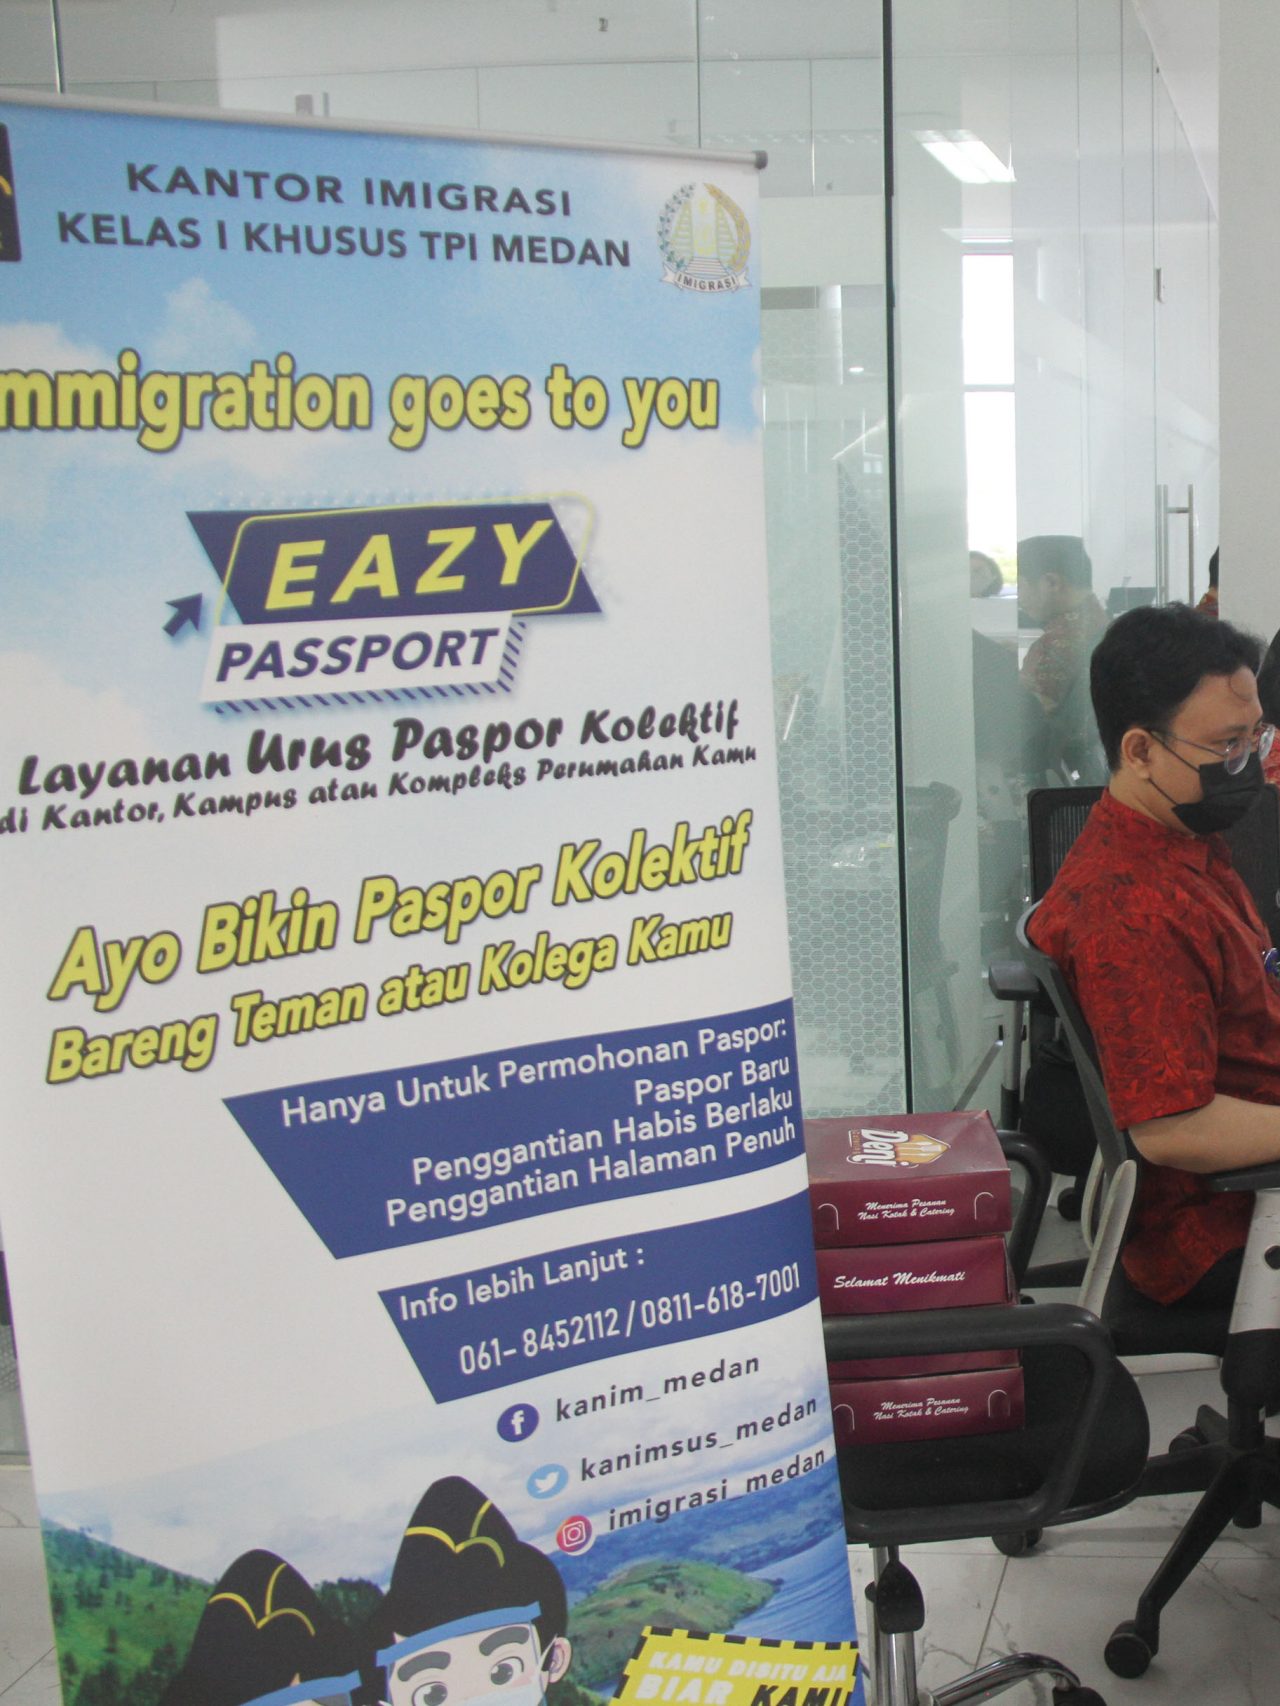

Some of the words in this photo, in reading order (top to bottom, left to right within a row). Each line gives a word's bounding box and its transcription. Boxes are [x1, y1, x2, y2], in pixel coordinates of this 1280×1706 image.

[127, 163, 343, 204] KANTOR
[364, 177, 571, 217] IMIGRASI
[57, 211, 201, 249] KELAS
[217, 219, 227, 250] I
[244, 222, 407, 259] KHUSUS
[420, 231, 477, 261] TPI
[492, 235, 630, 267] MEDAN
[676, 273, 736, 291] IMIGRASI
[389, 373, 532, 450] goes
[547, 364, 608, 430] to
[622, 377, 720, 448] you
[264, 519, 553, 610] EAZY
[215, 628, 499, 682] PASSPORT
[18, 753, 231, 797] Layanan
[247, 729, 371, 773] Urus
[392, 717, 564, 764] Paspor
[579, 699, 740, 744] Kolektif
[0, 806, 28, 834] di
[41, 799, 165, 832] Kantor,
[172, 787, 297, 819] Kampus
[308, 779, 378, 806] atau
[389, 764, 527, 798] Kompleks
[536, 753, 683, 780] Perumahan
[691, 744, 757, 767] Kamu
[46, 925, 182, 1012] Ayo
[198, 888, 337, 972] Bikin
[353, 862, 540, 944] Paspor
[552, 809, 754, 907] Kolektif
[45, 1012, 219, 1085] Bareng
[230, 982, 366, 1048] Teman
[377, 960, 469, 1018] atau
[478, 931, 615, 995] Kolega
[626, 908, 734, 968] Kamu
[281, 1091, 388, 1128] Hanya
[396, 1072, 491, 1106] Untuk
[498, 1038, 690, 1090] Permohonan
[697, 1018, 788, 1060] Paspor:
[634, 1071, 732, 1109] Paspor
[741, 1054, 791, 1086] Baru
[412, 1125, 603, 1188] Penggantian
[612, 1110, 698, 1145] Habis
[705, 1088, 794, 1129] Berlaku
[386, 1166, 579, 1228] Penggantian
[589, 1143, 718, 1186] Halaman
[725, 1118, 797, 1152] Penuh
[865, 1201, 910, 1211] Menerima
[912, 1198, 947, 1209] Pesanan
[858, 1211, 879, 1220] Nasi
[911, 1207, 917, 1217] &
[919, 1206, 955, 1217] Catering
[400, 1287, 458, 1321] Info
[467, 1270, 535, 1308] lebih
[543, 1247, 628, 1284] Lanjut
[833, 1275, 888, 1290] Selamat
[892, 1271, 966, 1287] Menikmati
[459, 1337, 518, 1376] 061-
[522, 1306, 620, 1357] 8452112
[556, 1355, 759, 1423] kanim_medan
[881, 1400, 924, 1411] Menerima
[927, 1397, 961, 1408] Pesanan
[935, 1404, 969, 1415] Catering
[580, 1397, 818, 1482] kanimsus_medan
[608, 1449, 827, 1532] imigrasi_medan
[635, 1673, 734, 1705] BIAR
[751, 1684, 843, 1706] KAMI
[651, 1651, 724, 1674] KAMU
[728, 1660, 809, 1682] DISITU
[812, 1665, 847, 1682] AJA
